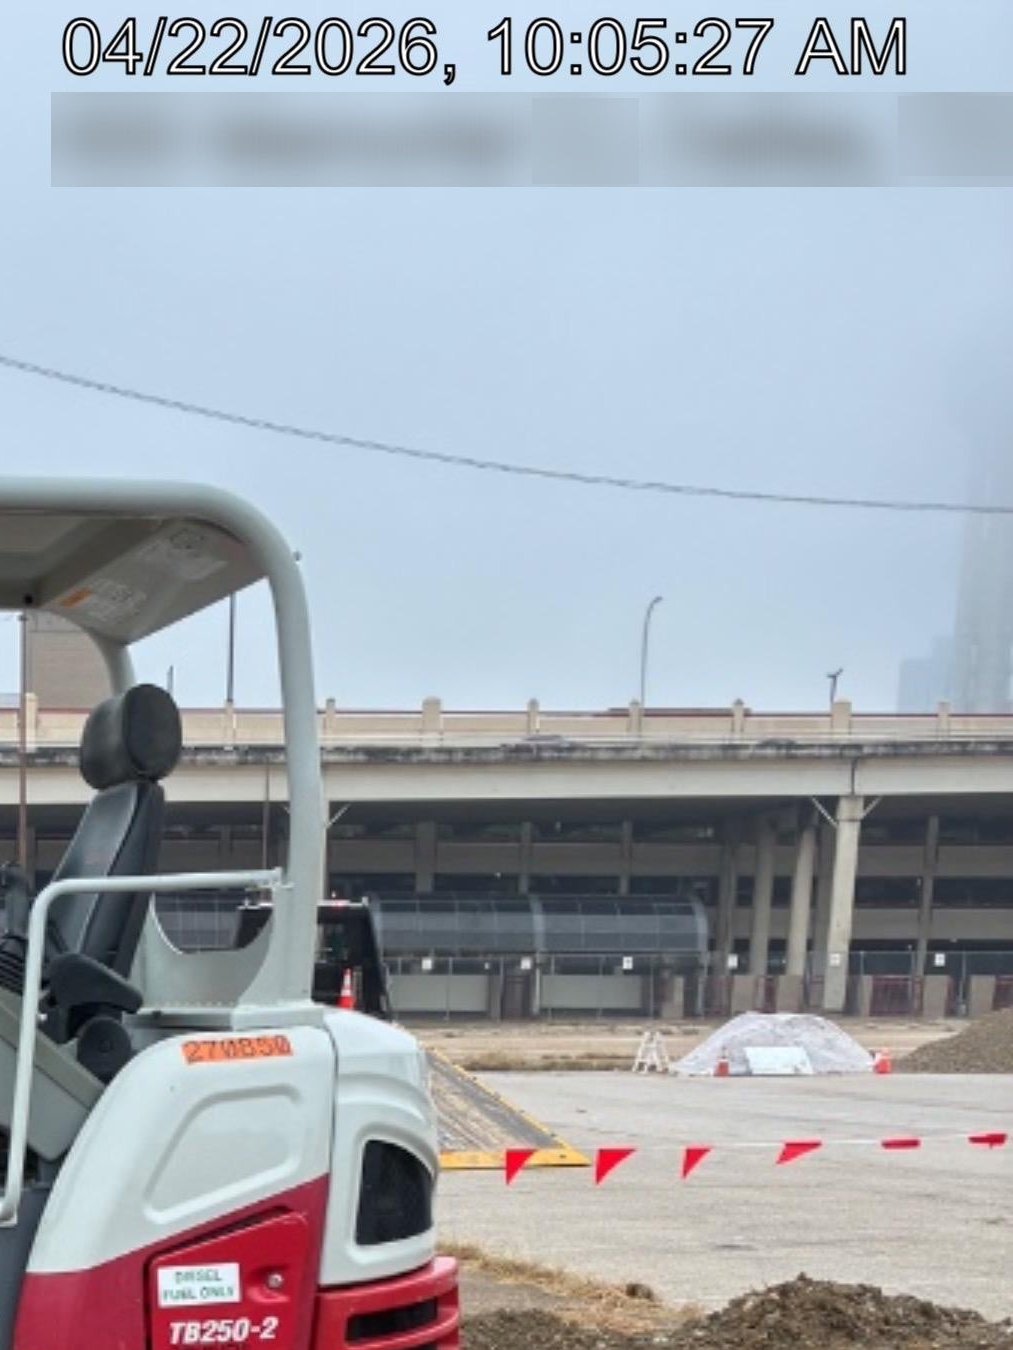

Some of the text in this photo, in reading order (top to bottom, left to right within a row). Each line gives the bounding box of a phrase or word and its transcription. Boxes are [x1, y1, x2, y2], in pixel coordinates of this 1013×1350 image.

[176, 1268, 223, 1284] DIESEL
[163, 1285, 234, 1301] FUEL ONLY
[169, 1315, 279, 1345] TB250-2
